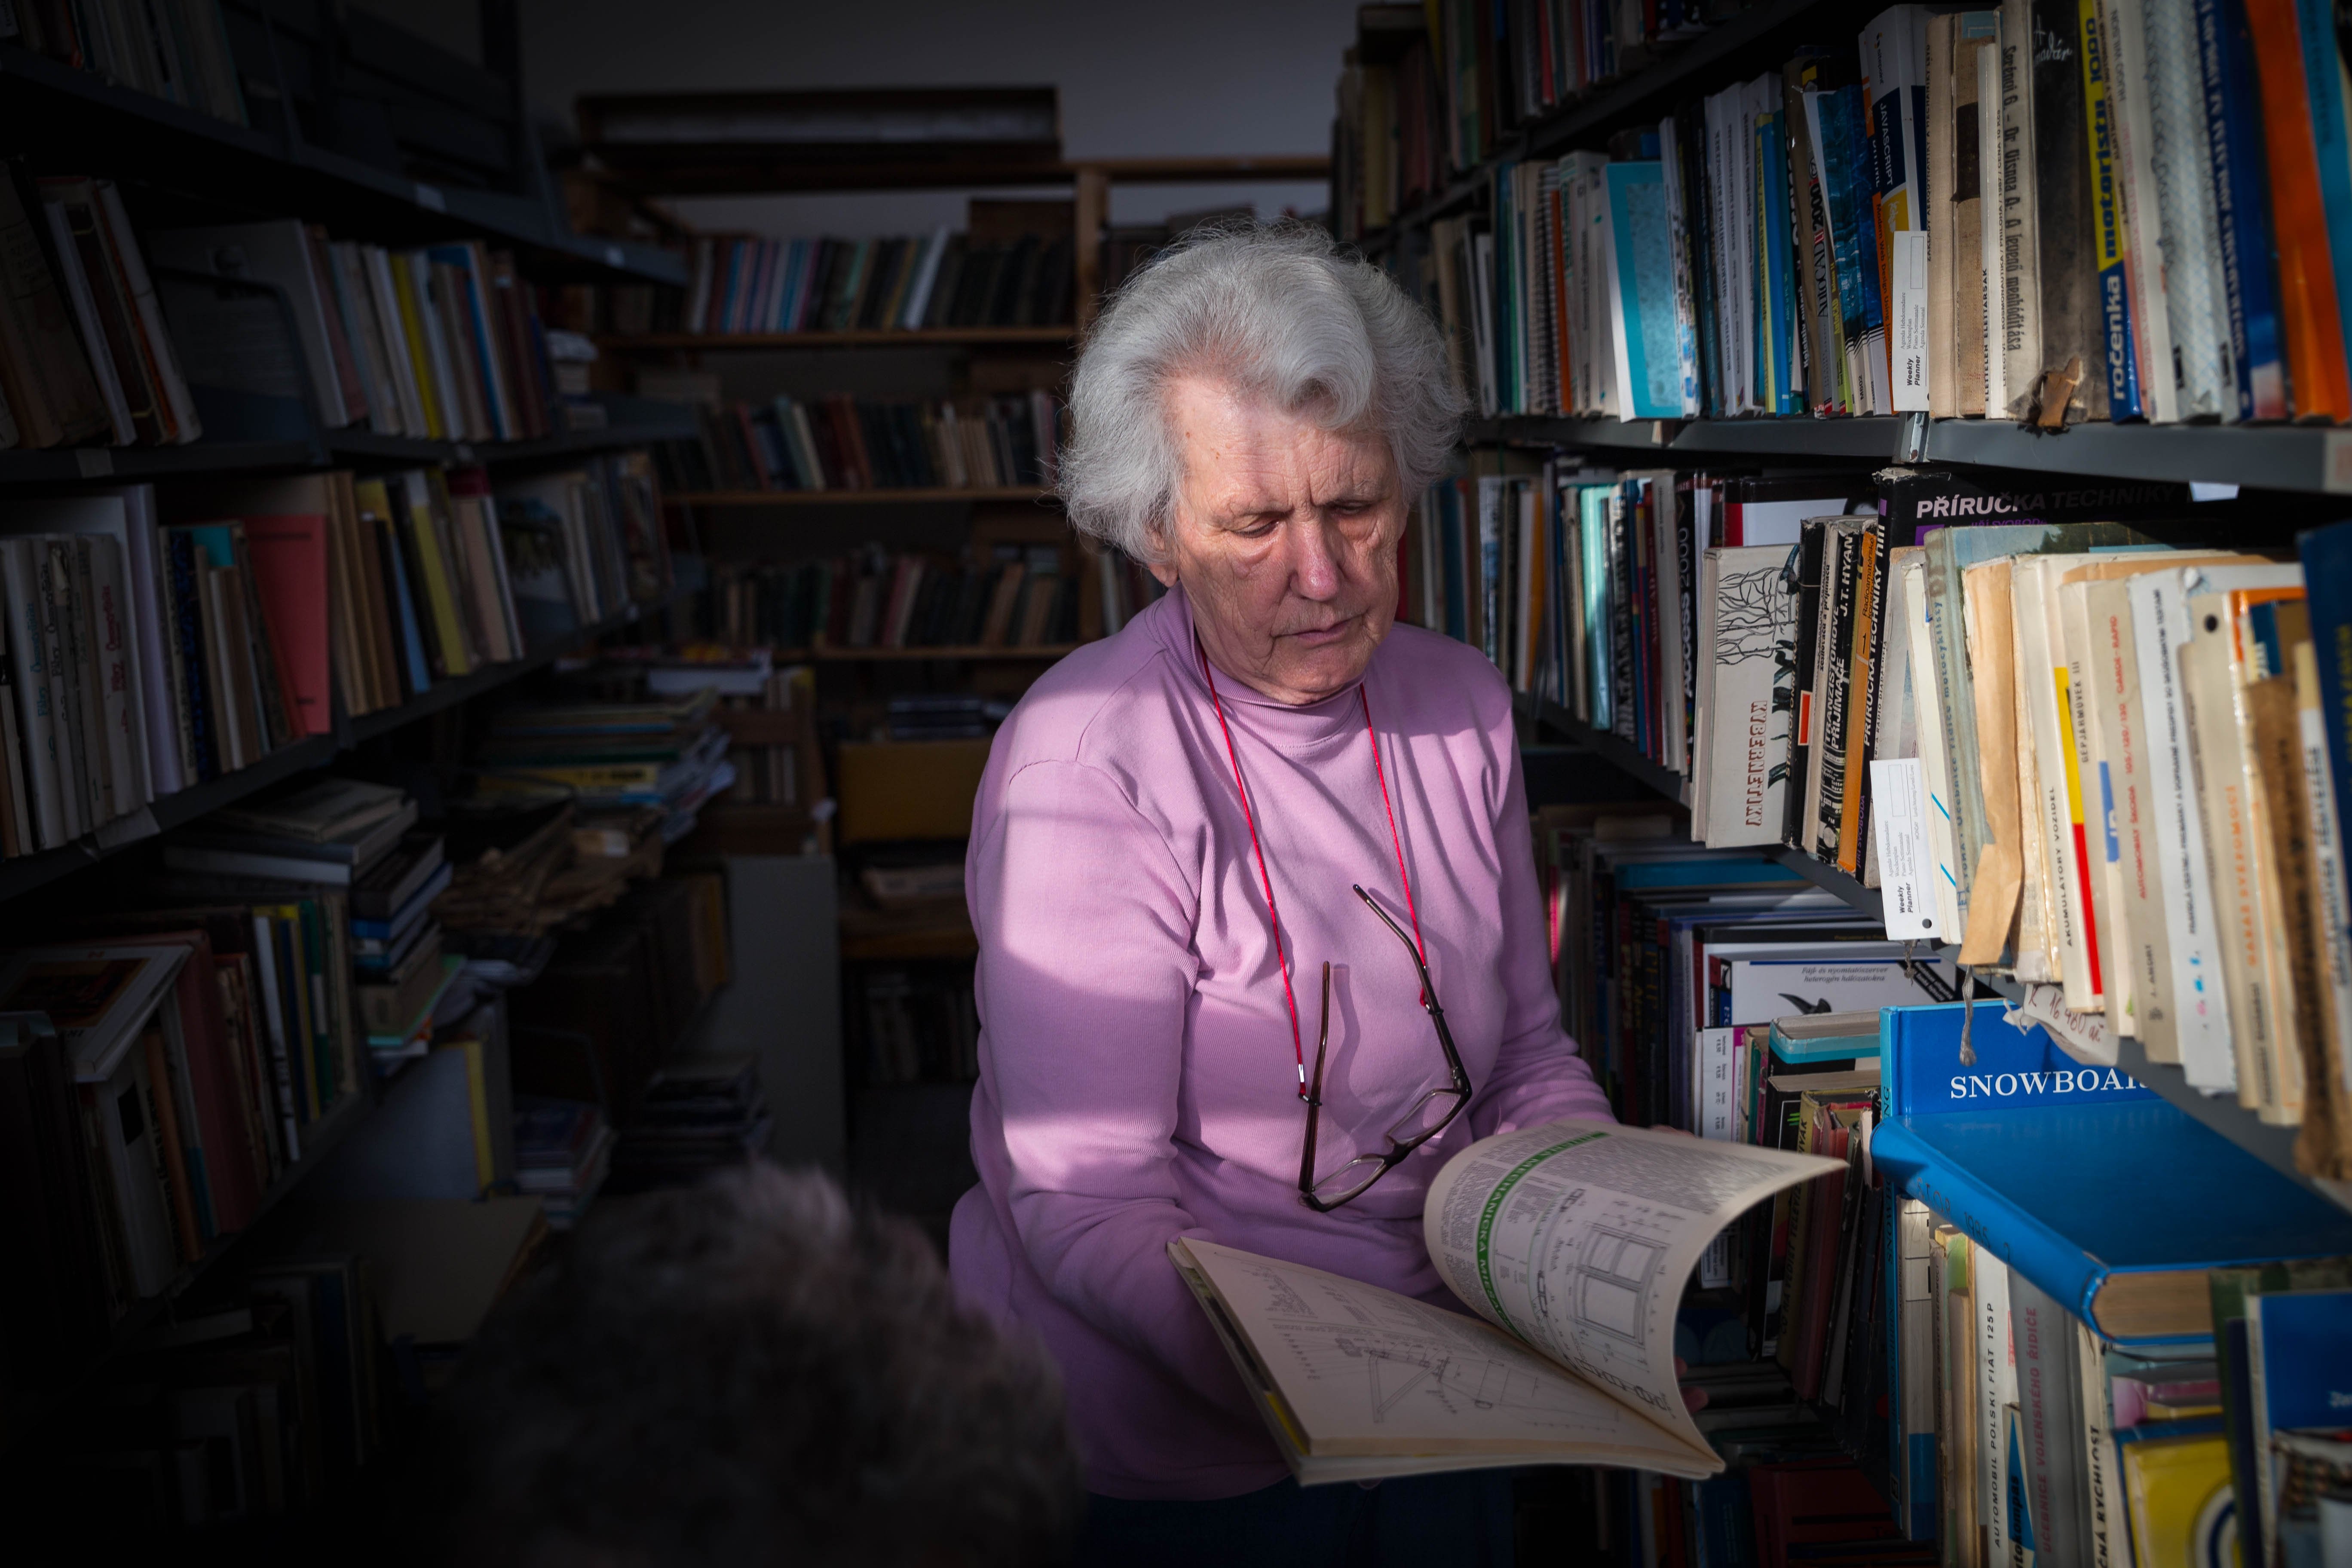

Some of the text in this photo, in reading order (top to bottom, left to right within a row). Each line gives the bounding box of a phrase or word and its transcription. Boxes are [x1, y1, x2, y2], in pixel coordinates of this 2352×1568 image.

[2085, 17, 2102, 84] 1000
[2110, 8, 2127, 101] HUGO WILSON
[1880, 102, 1893, 186] JAVASCRIPT
[1813, 228, 1825, 244] LT
[1876, 203, 1884, 239] Modern
[1813, 242, 1828, 318] AutoCAD
[1880, 263, 1889, 294] Design
[1831, 298, 1841, 334] AutoCAD
[1882, 295, 1890, 322] Using
[2106, 274, 2126, 400] ročenka
[1915, 493, 2047, 519] PŘÍRUČKA
[1842, 536, 1853, 585] HYAN
[1677, 527, 1693, 698] Access 2000
[1870, 564, 1882, 653] TECHNIKY
[1932, 601, 1950, 698] motocyklisty
[1745, 700, 1768, 828] KYBERNETIKY
[1857, 795, 1865, 847] SVOBODA
[2128, 785, 2140, 824] ŠKODA
[1883, 820, 1892, 858] Hebdomadaire
[2048, 786, 2073, 947] AKUMULÁTORY VOZIDEL
[2132, 828, 2147, 899] AUTOMOBILY
[1897, 885, 1906, 914] Weekly
[1905, 882, 1914, 913] Planner
[1987, 1348, 1995, 1384] FIAT
[1988, 1392, 1997, 1450] POLSKI
[2025, 1307, 2053, 1553] UČEBNICE VOJENSKÉHO ŘIDIČE
[1991, 1457, 2000, 1549] AUTOMOBIL
